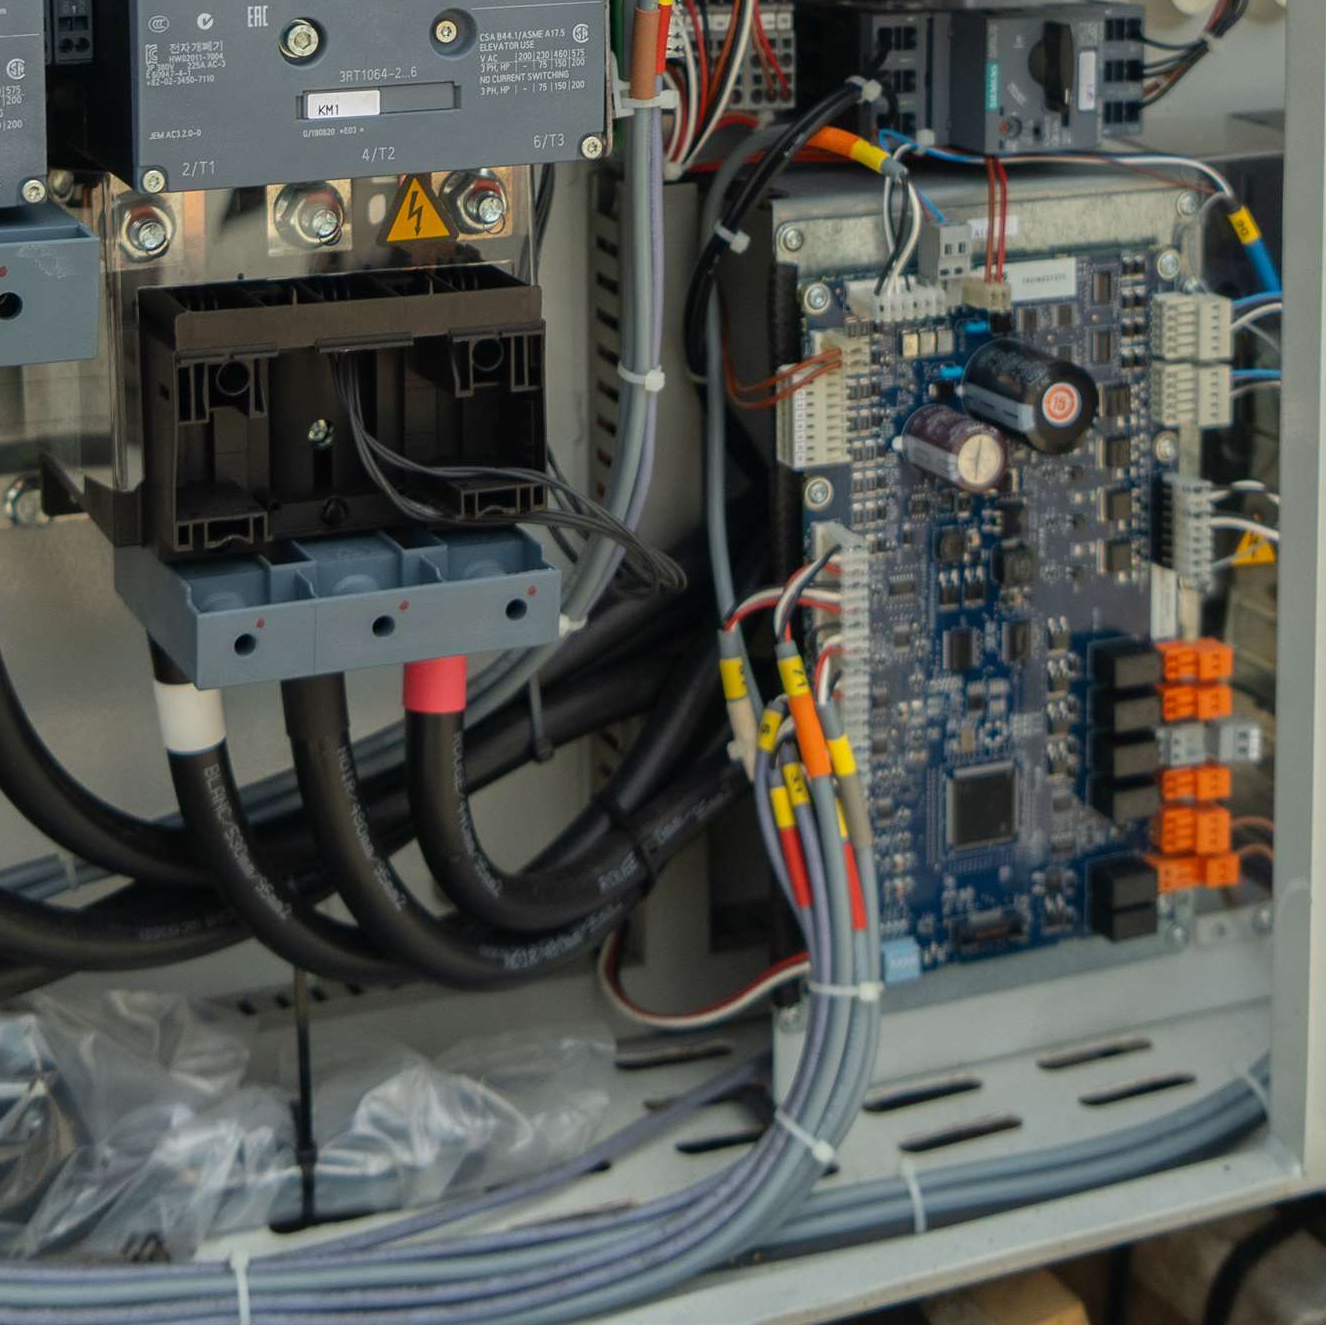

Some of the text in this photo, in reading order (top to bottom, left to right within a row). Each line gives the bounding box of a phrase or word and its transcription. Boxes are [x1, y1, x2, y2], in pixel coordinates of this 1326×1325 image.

[6, 85, 21, 94] 575
[6, 96, 22, 104] 200
[318, 105, 339, 116] KM1
[182, 134, 565, 176] 2/T1 4/T2 6/T3
